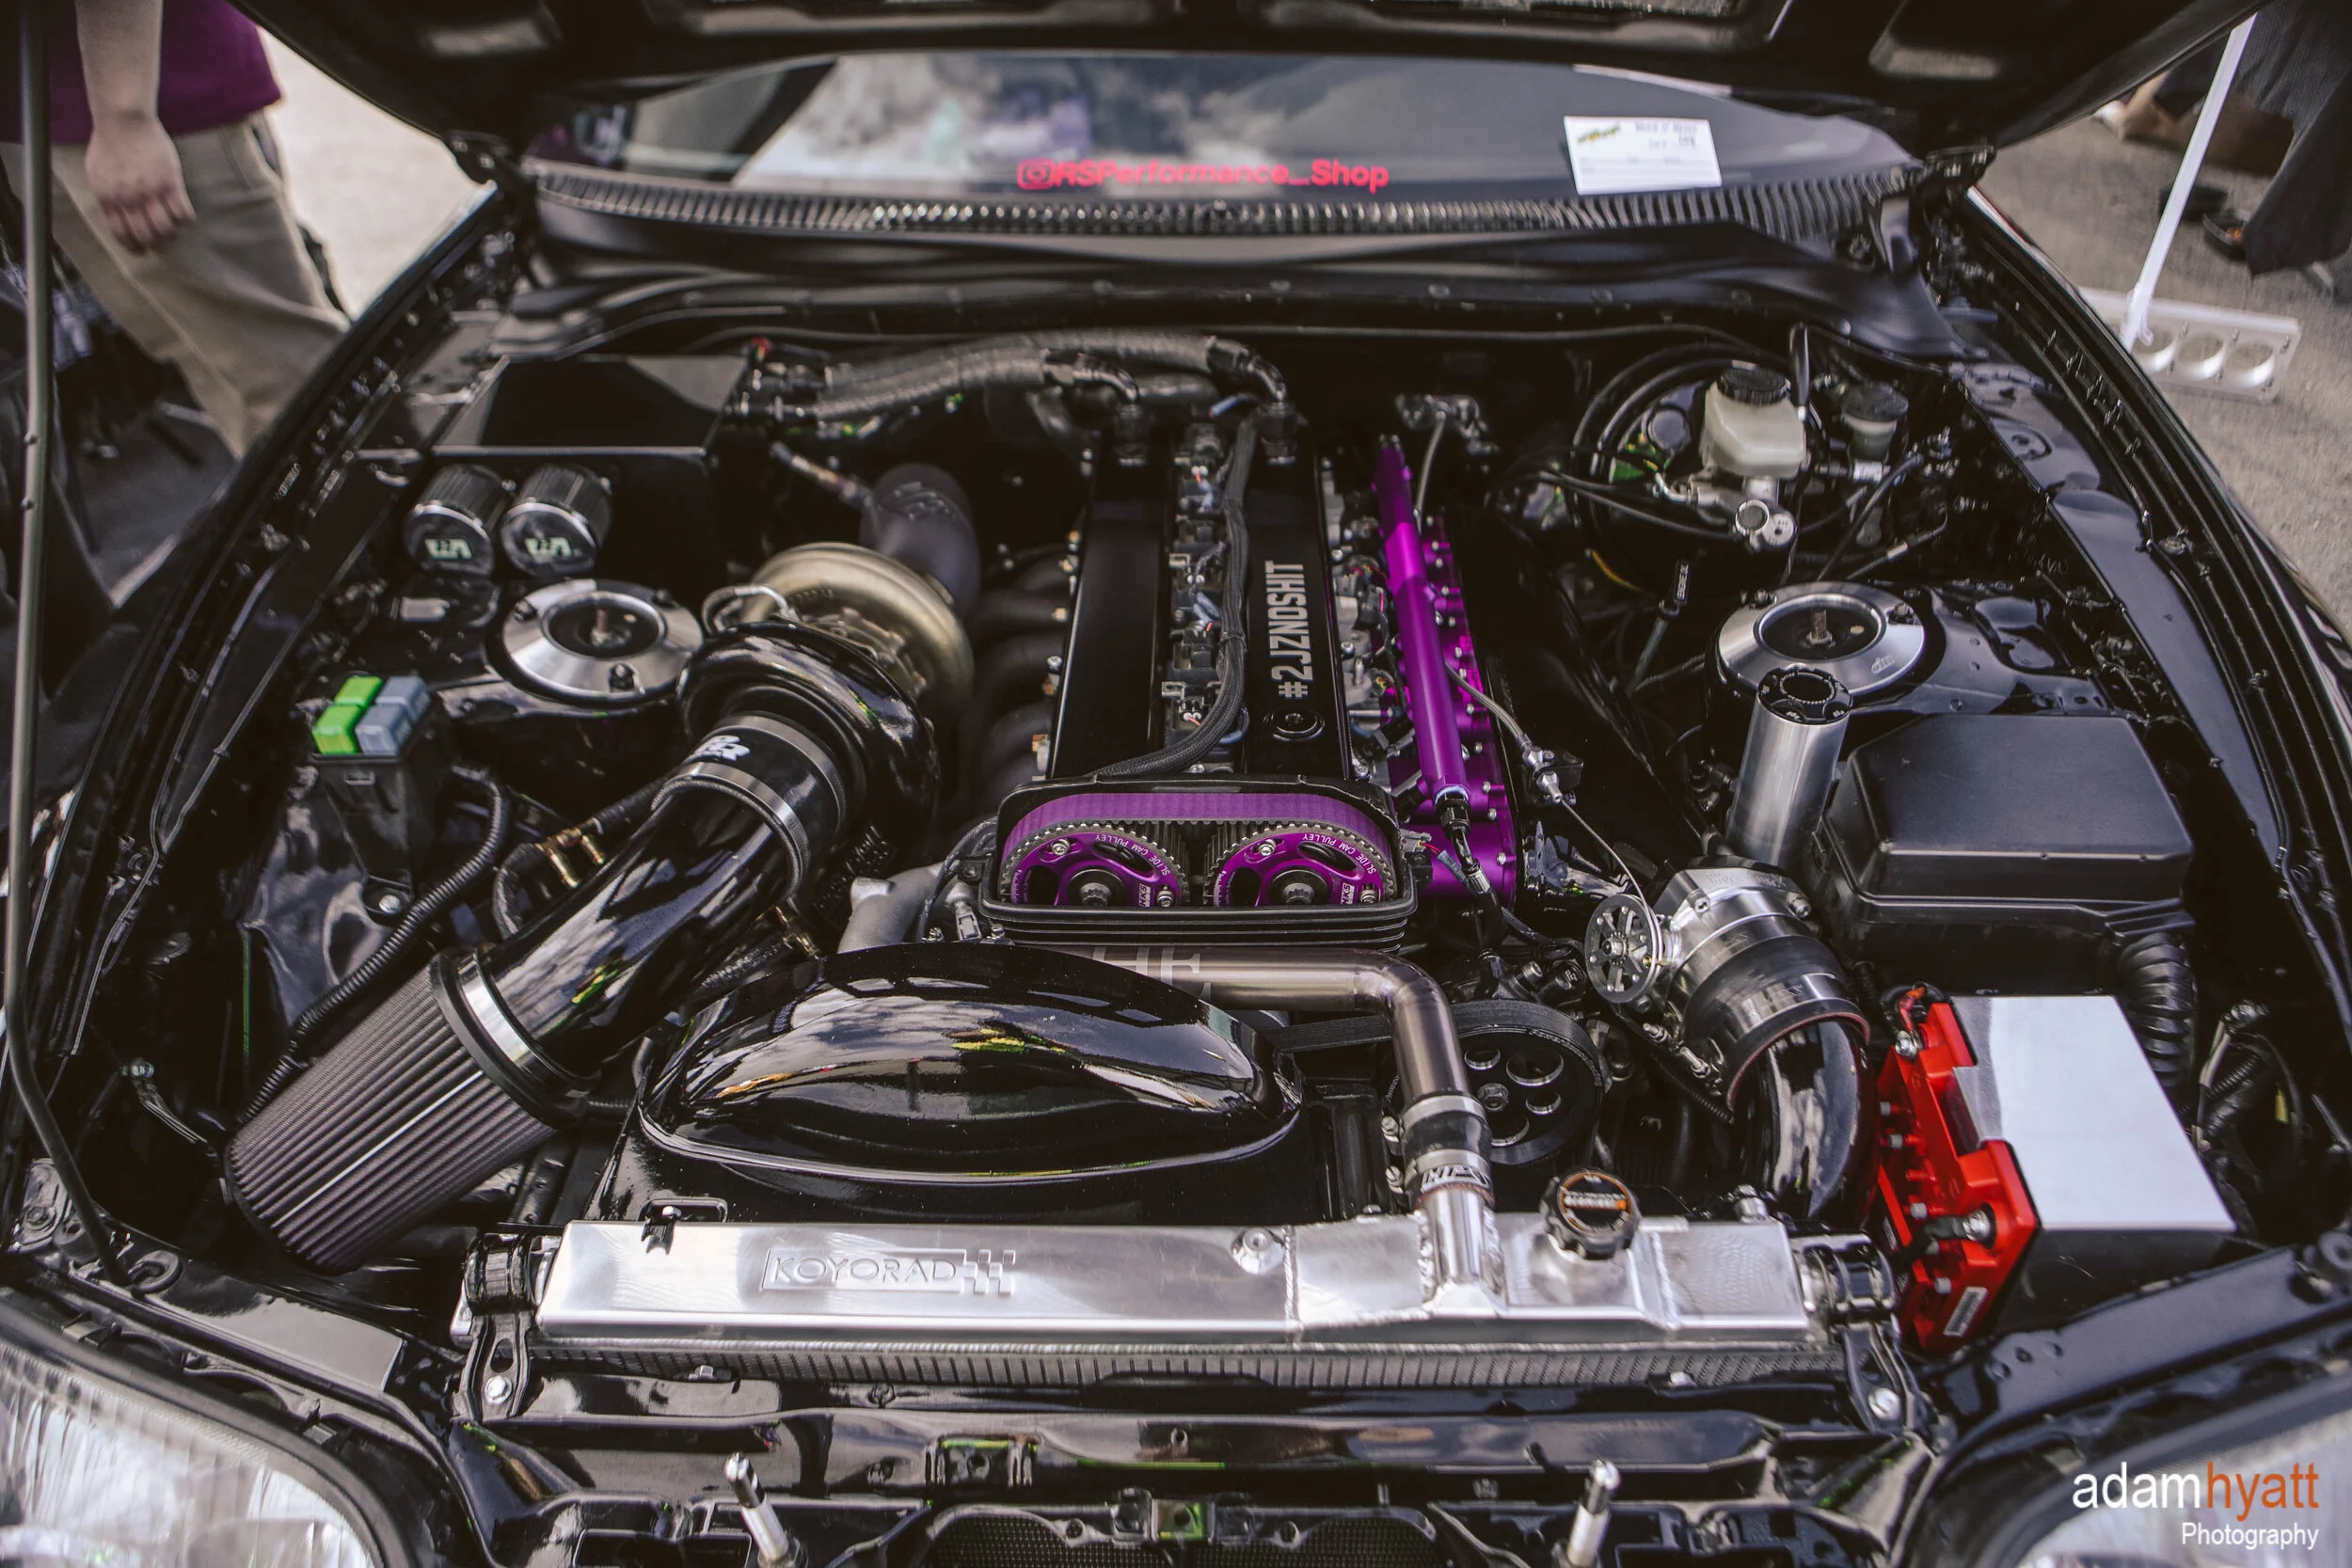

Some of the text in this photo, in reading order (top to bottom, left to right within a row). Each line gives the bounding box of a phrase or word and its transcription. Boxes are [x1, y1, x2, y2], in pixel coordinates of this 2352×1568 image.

[1264, 560, 1313, 700] #2JZNOSHIT
[1095, 834, 1171, 876] SLIDE CAM PULLEY
[1302, 833, 1376, 875] SLIDE CAM PULLEY
[1138, 883, 1151, 908] HKS
[771, 1257, 957, 1283] KOYORAD
